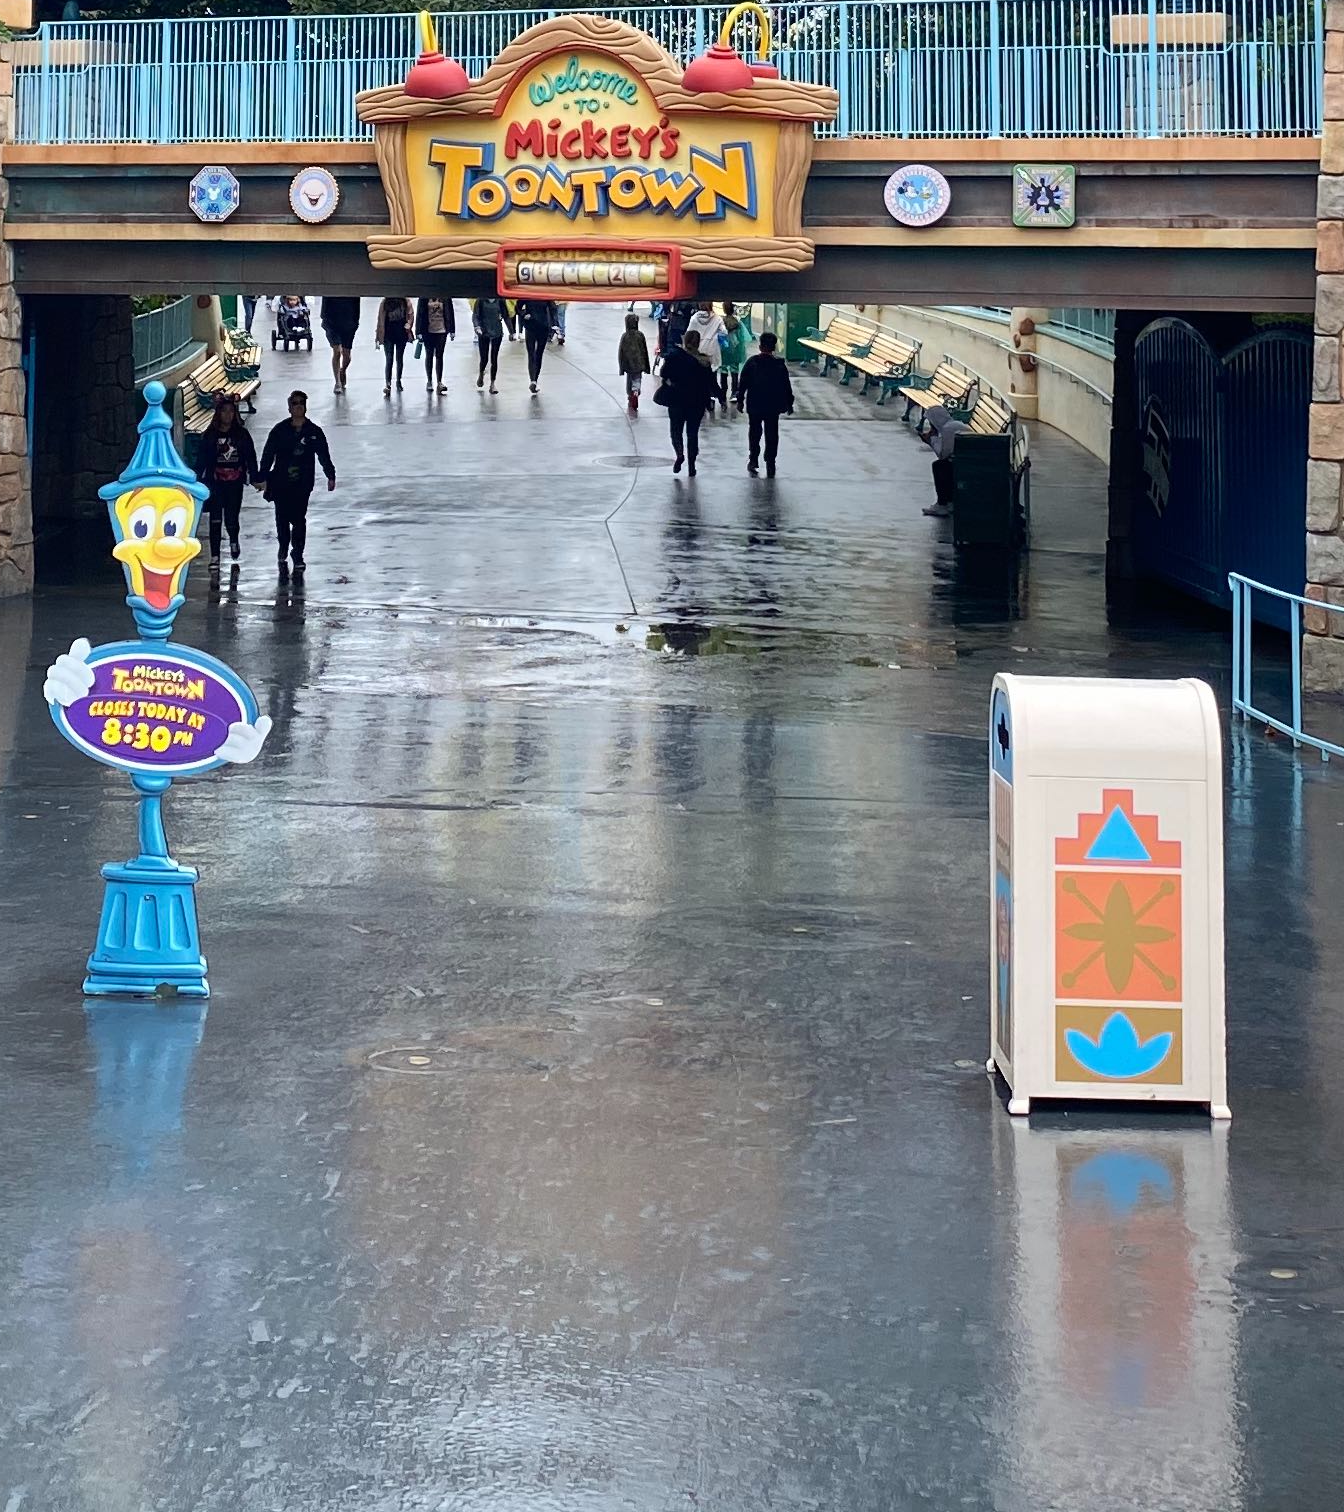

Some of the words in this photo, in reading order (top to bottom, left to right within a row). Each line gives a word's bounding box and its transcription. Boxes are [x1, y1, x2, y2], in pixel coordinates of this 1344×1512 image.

[528, 55, 639, 108] Welcome
[575, 99, 600, 114] TO
[428, 138, 757, 222] TOONTOWN
[111, 667, 206, 701] TOONTOWN
[88, 700, 135, 718] CLOSES
[138, 701, 187, 725] TODAY
[187, 711, 206, 731] AT
[101, 718, 172, 753] 8:30
[172, 730, 194, 747] PM
